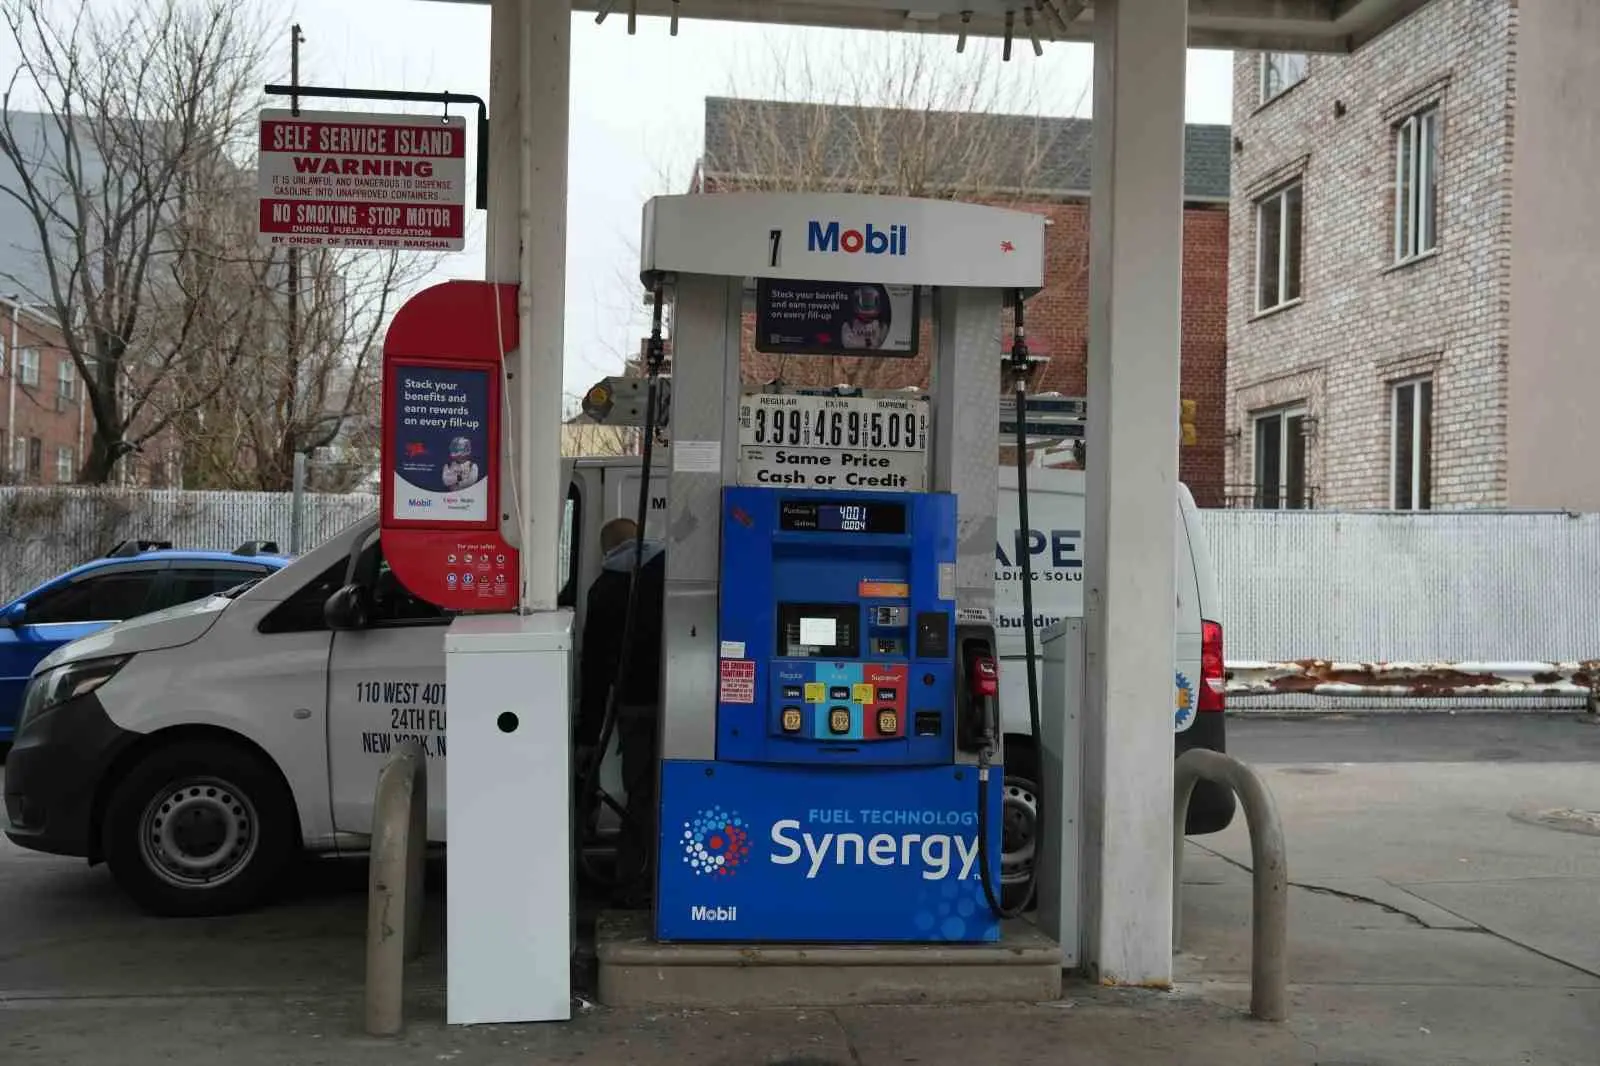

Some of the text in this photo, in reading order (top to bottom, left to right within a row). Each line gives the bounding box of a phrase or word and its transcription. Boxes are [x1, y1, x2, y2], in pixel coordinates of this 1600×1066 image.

[273, 125, 453, 155] SELF SERVICE ISLAND
[292, 157, 433, 177] WARNING
[273, 175, 452, 189] IT IS UNLAWFUL AND DANGEROUS TO DISPENSE
[274, 186, 438, 200] GASOLINE INTO UNAPPROVED CONTAINERS
[273, 203, 451, 227] NO SMOKING STOP MOTOR
[292, 225, 432, 236] DURING FUELING OPERATION
[808, 221, 907, 255] Mobil
[289, 237, 322, 245] ORDER
[344, 238, 375, 246] STATE
[403, 239, 450, 248] MARSHAL
[769, 230, 781, 267] 7
[771, 290, 848, 301] Stack your benefits
[771, 300, 786, 308] and
[808, 302, 840, 310] rewards
[783, 312, 805, 320] every
[807, 311, 832, 320] fill-up
[405, 378, 458, 392] Stack your
[404, 391, 466, 403] benefits and
[760, 397, 797, 406] REGULAR
[404, 405, 469, 415] earn rewards
[404, 418, 479, 430] on every fill-up
[755, 409, 800, 445] 3.99
[814, 409, 859, 446] 4.69
[871, 412, 916, 448] 5.09
[775, 450, 831, 466] Same
[841, 453, 890, 467] Price
[757, 469, 908, 487] Cash or Credit
[408, 498, 432, 507] Mobil
[652, 497, 666, 510] M
[1045, 571, 1082, 581] SOLU
[356, 682, 380, 703] 110
[384, 682, 419, 704] WEST
[391, 708, 446, 730] 24TH FL
[362, 732, 391, 754] NEW
[809, 809, 854, 824] FUEL
[770, 819, 979, 880] Synergy
[691, 906, 736, 921] Mobil
